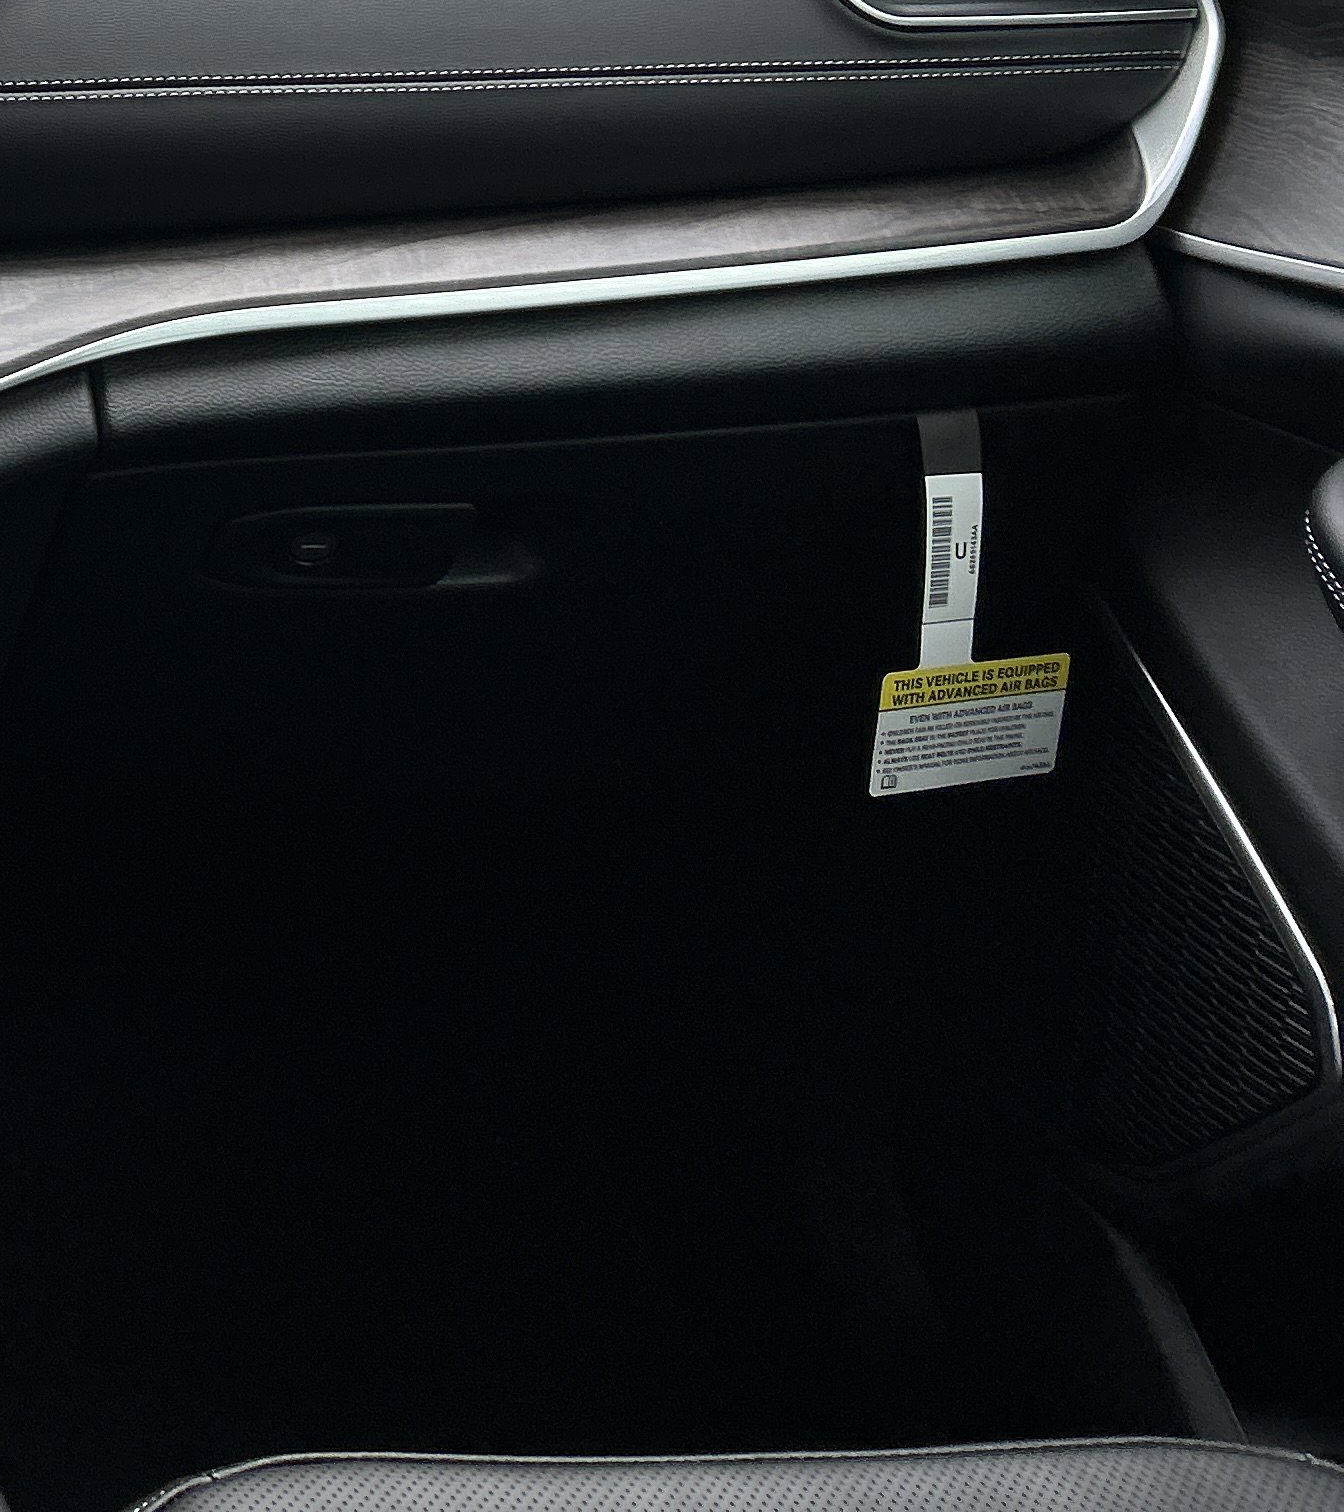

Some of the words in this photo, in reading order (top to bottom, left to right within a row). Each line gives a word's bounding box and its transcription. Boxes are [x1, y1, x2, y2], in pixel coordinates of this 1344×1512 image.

[955, 541, 967, 560] U
[894, 678, 923, 692] THIS
[926, 672, 979, 688] VEHICLE
[982, 669, 994, 681] IS
[997, 661, 1060, 679] EQUIPPED
[891, 693, 926, 707] WITH
[927, 684, 998, 703] ADVANCED
[1001, 680, 1022, 693] AIR
[1024, 676, 1058, 690] BAGS
[932, 711, 952, 721] WITH
[953, 705, 997, 719] ADVANCED
[997, 703, 1010, 711] AIR
[1012, 701, 1033, 711] BAGS
